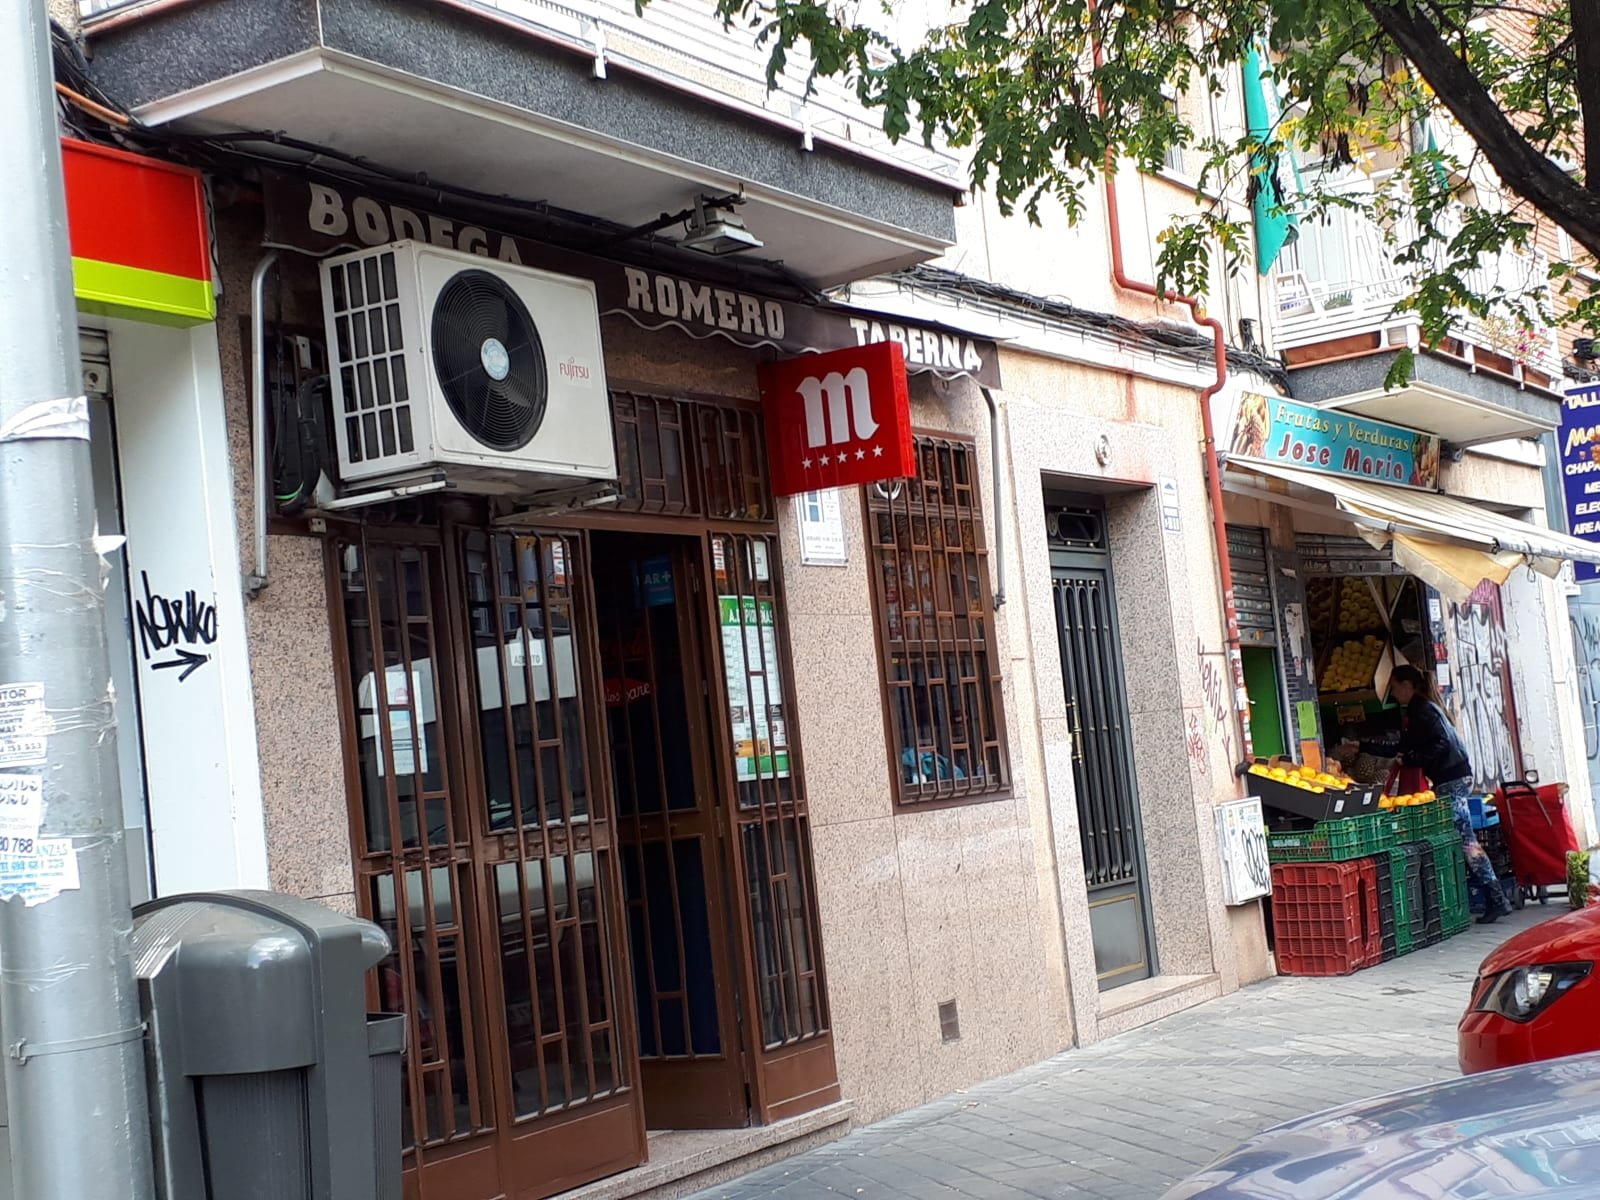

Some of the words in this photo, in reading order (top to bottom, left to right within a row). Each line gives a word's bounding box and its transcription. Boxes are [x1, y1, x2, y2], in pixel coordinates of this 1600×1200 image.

[309, 182, 523, 265] BODEGA
[624, 267, 786, 340] ROMERO
[849, 317, 982, 371] TABERNA
[559, 361, 590, 380] FUJITSU
[1275, 404, 1330, 433] Frutas
[1332, 423, 1343, 442] y
[1347, 421, 1410, 452] Verduras
[1278, 432, 1331, 466] Jose
[1342, 446, 1405, 480] Maria
[0, 688, 27, 700] TOR
[12, 838, 34, 853] 768
